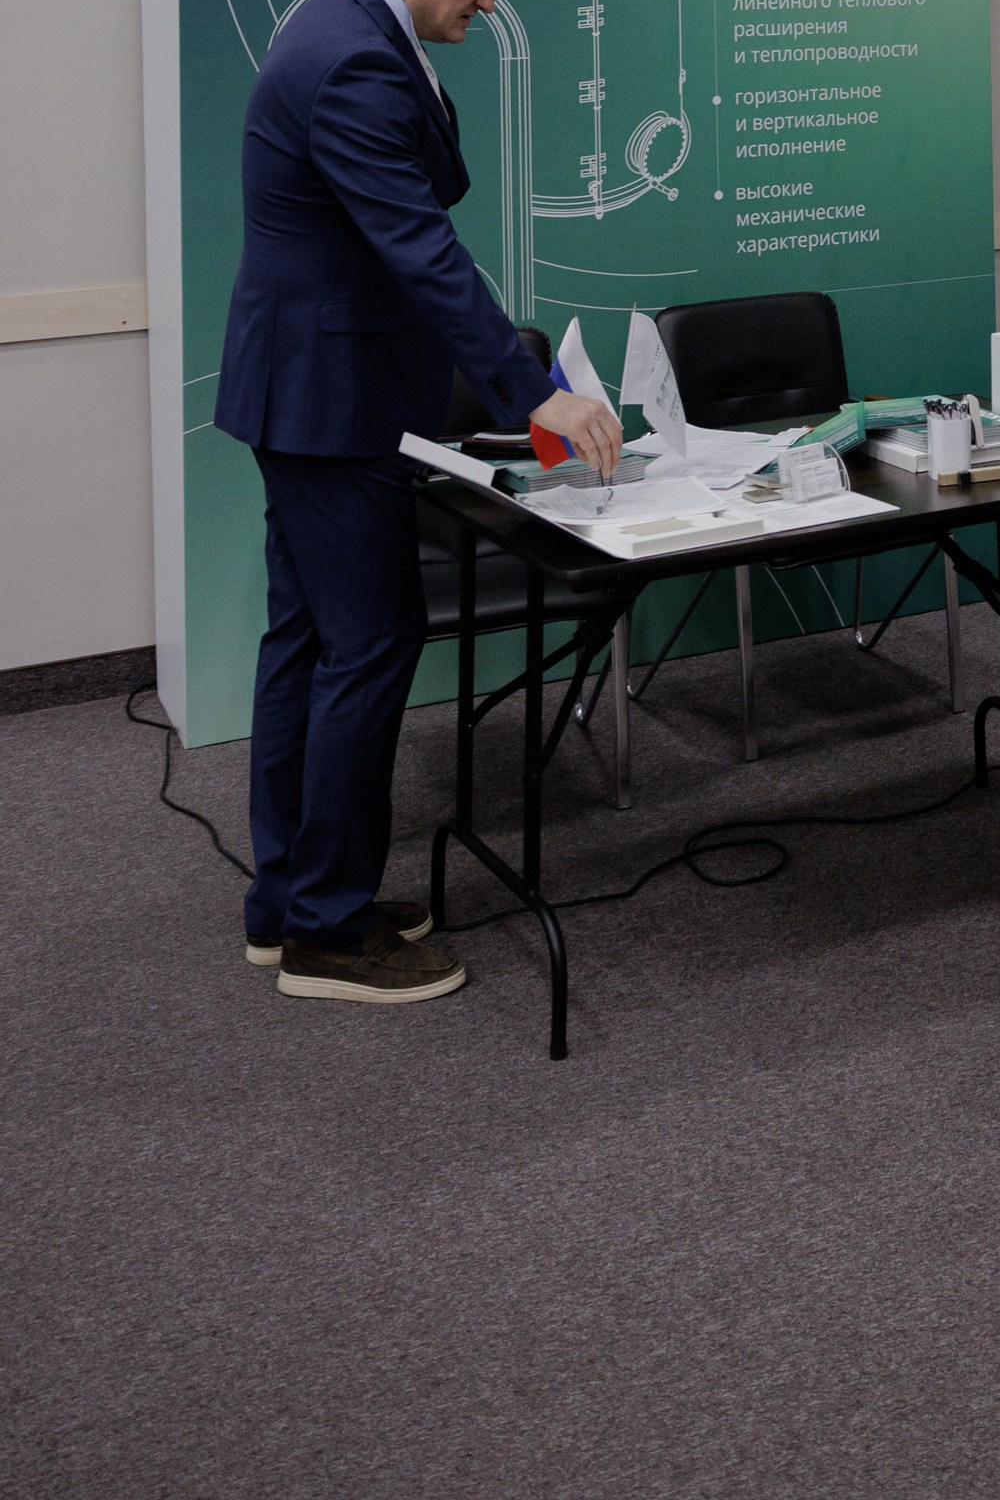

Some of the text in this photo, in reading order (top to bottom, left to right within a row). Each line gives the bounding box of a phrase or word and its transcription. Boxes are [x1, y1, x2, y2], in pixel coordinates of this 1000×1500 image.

[734, 21, 847, 42] расширения
[735, 44, 917, 65] и теплопроводности
[736, 86, 881, 108] горизонтальное
[736, 110, 879, 133] и вертикальное
[737, 139, 846, 158] исполнение
[736, 183, 813, 200] высокие
[737, 204, 865, 226] механические
[737, 229, 879, 256] характеристики
